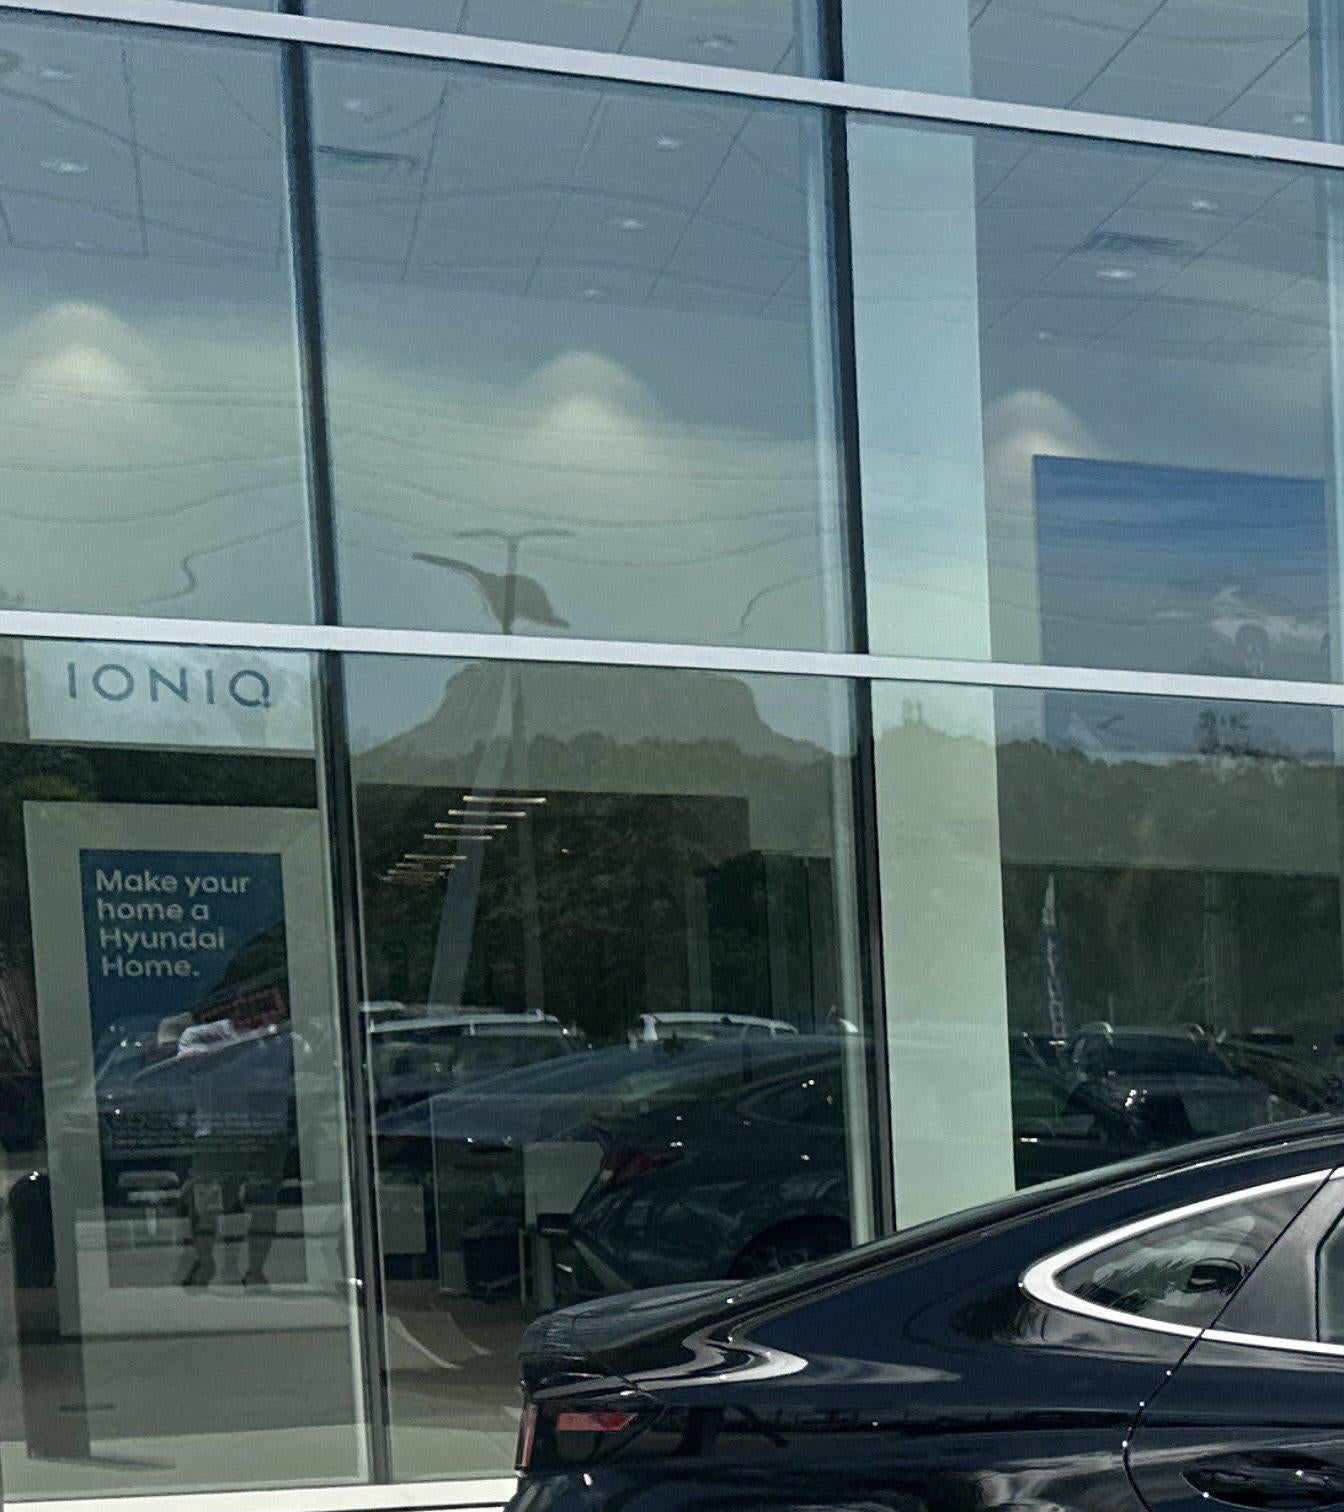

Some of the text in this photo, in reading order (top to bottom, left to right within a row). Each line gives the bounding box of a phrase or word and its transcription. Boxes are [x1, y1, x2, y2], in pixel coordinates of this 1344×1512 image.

[67, 662, 272, 708] IONIQ
[95, 869, 251, 898] Make your
[96, 898, 210, 922] home a
[100, 927, 225, 953] Hyundai
[102, 956, 201, 978] Home.
